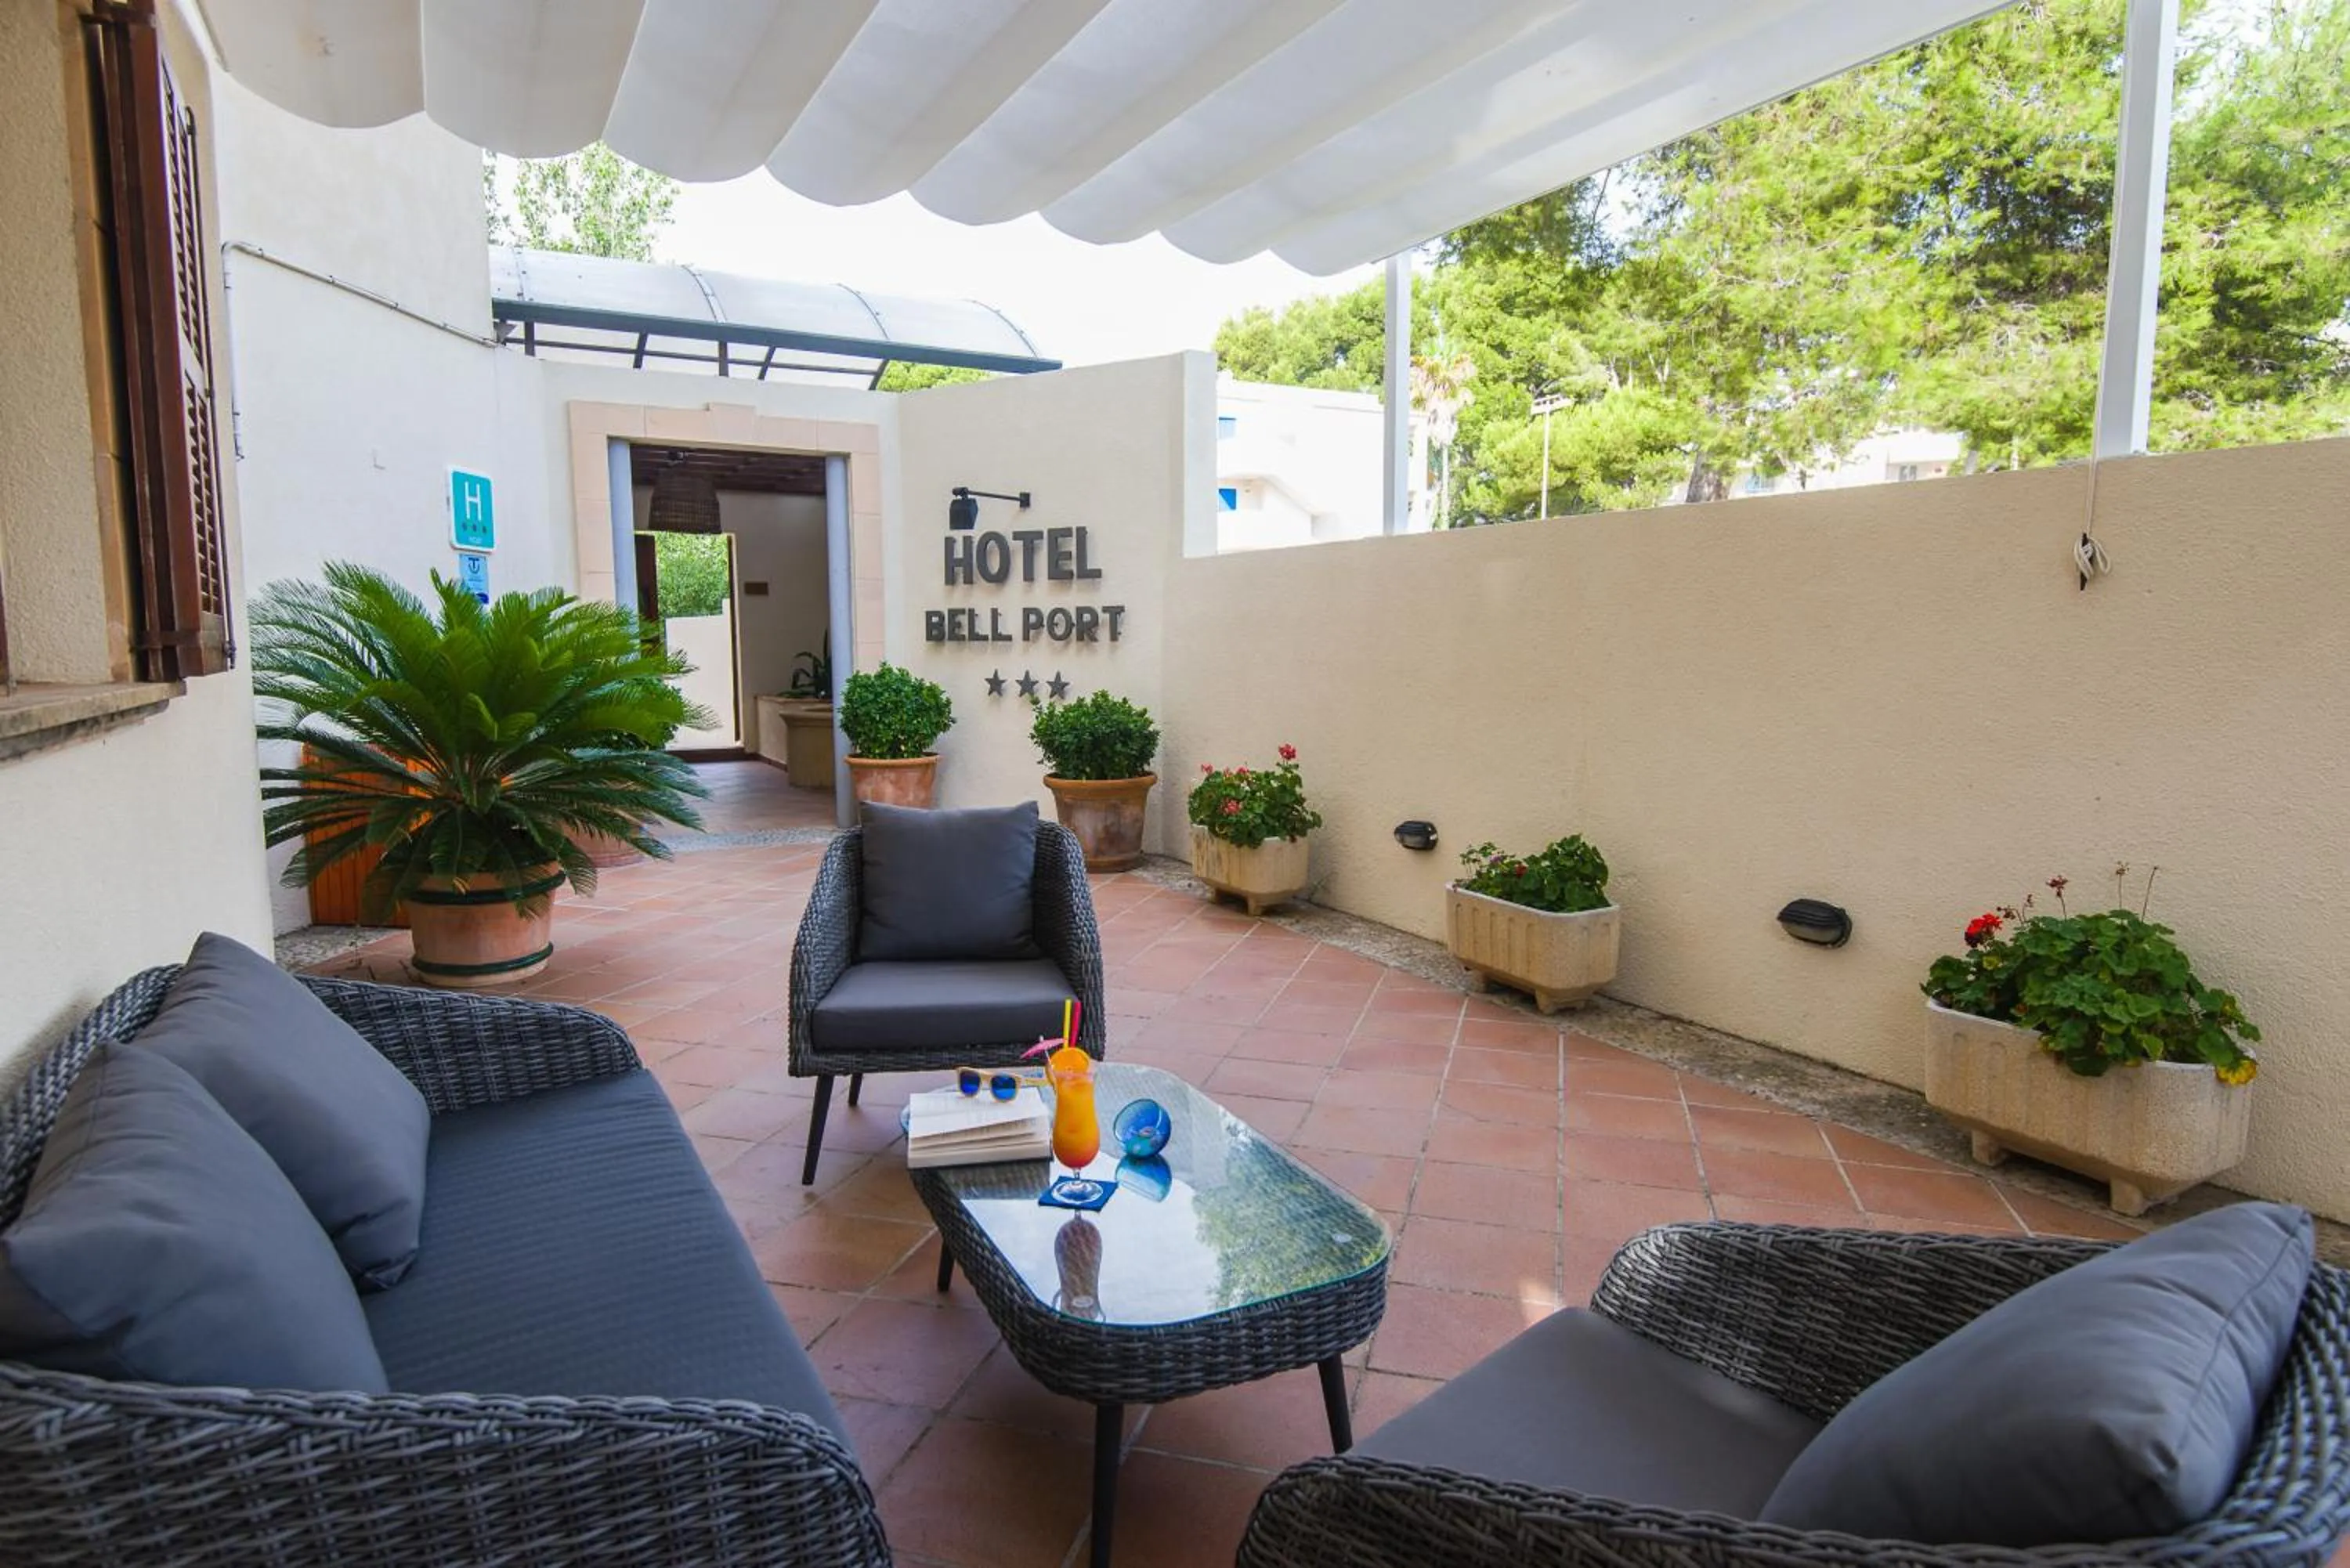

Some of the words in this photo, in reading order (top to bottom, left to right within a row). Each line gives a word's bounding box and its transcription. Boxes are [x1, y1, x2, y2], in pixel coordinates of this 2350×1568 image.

[465, 481, 482, 521] H
[944, 526, 1102, 585] HOTEL
[925, 608, 1013, 642] BELL
[1021, 605, 1126, 642] PORT
